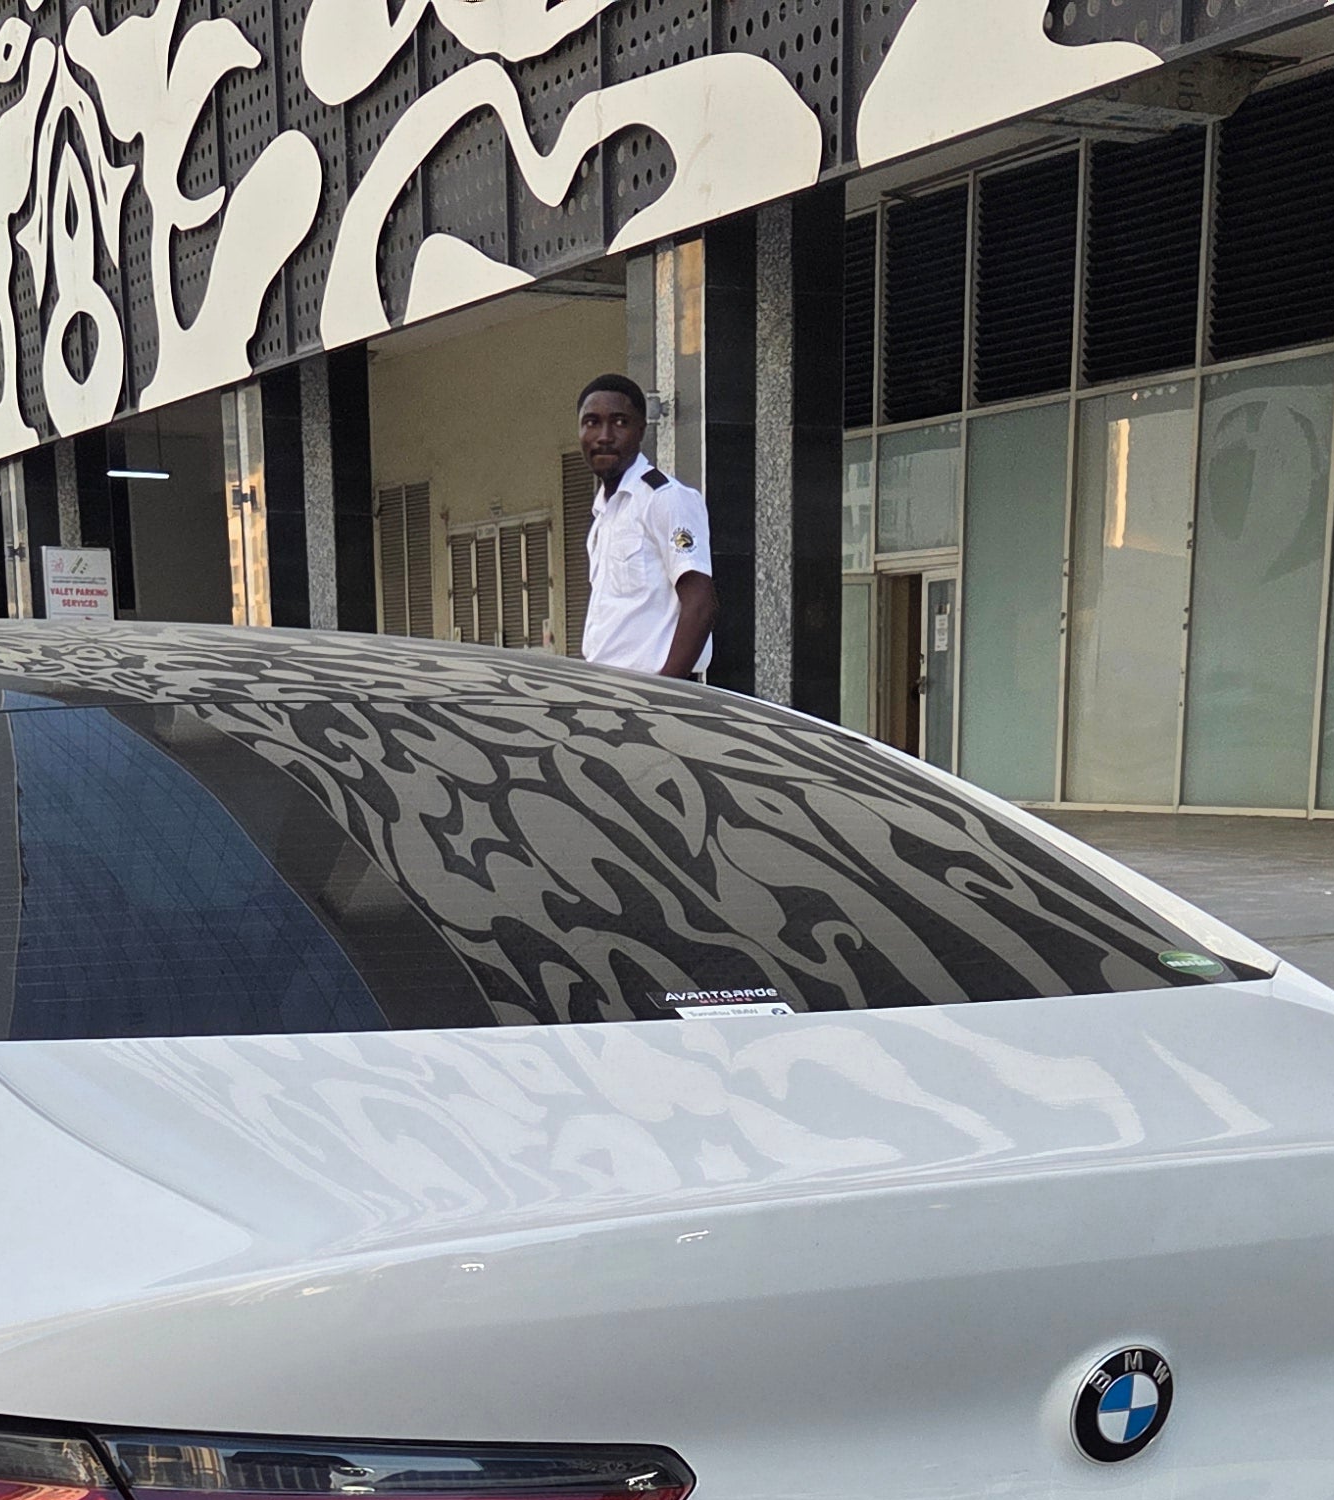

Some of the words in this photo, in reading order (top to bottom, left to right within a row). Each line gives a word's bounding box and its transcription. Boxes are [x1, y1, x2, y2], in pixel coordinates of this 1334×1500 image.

[50, 587, 74, 596] VALET
[75, 588, 109, 597] PARKING
[62, 599, 98, 608] SERVICES
[1088, 1350, 1170, 1394] BMW
